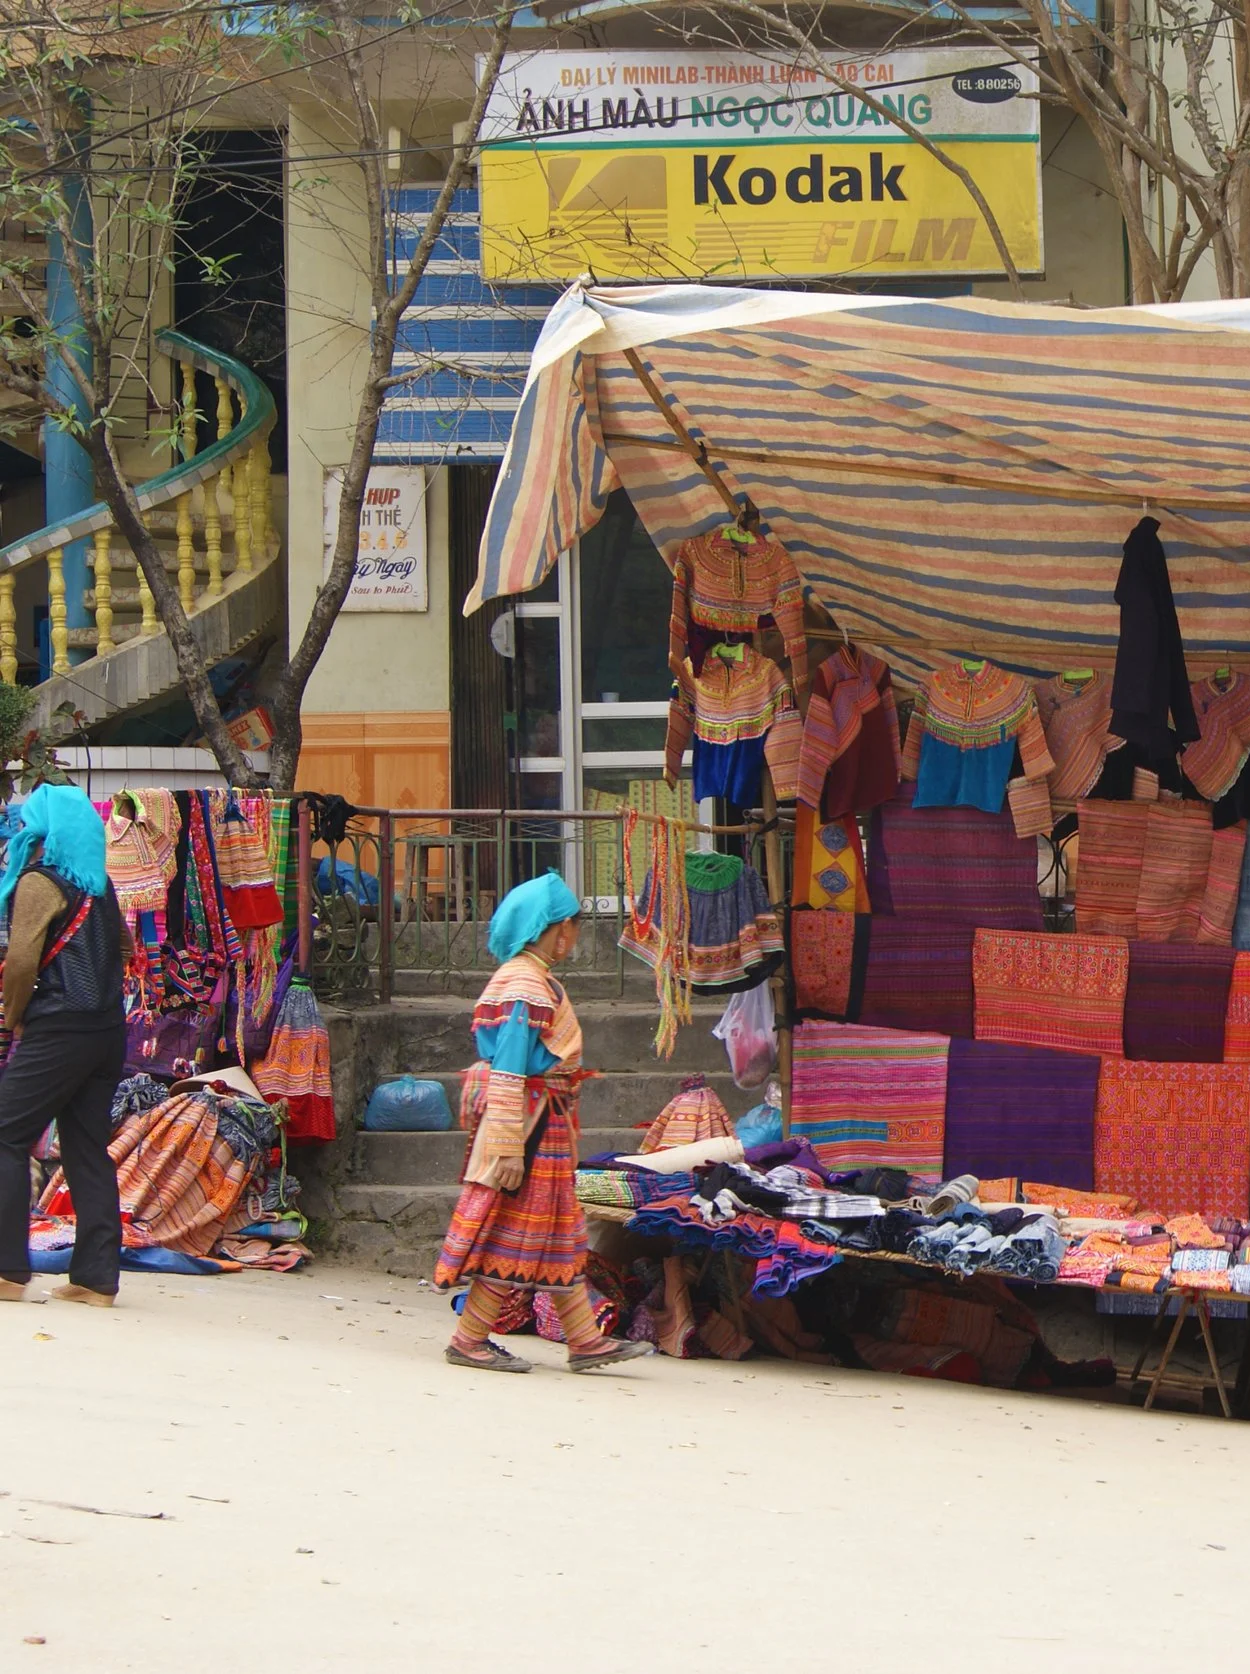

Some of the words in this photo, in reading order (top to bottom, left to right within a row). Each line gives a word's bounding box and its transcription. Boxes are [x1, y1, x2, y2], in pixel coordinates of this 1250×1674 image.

[863, 63, 894, 82] CAI
[957, 79, 973, 90] TEL
[516, 87, 591, 131] ẢNH
[602, 87, 679, 129] MÀU
[691, 96, 794, 134] NGỌC
[804, 93, 933, 128] QUANG
[693, 152, 908, 206] Kodak
[811, 218, 977, 264] FILM
[364, 487, 401, 507] HỤP
